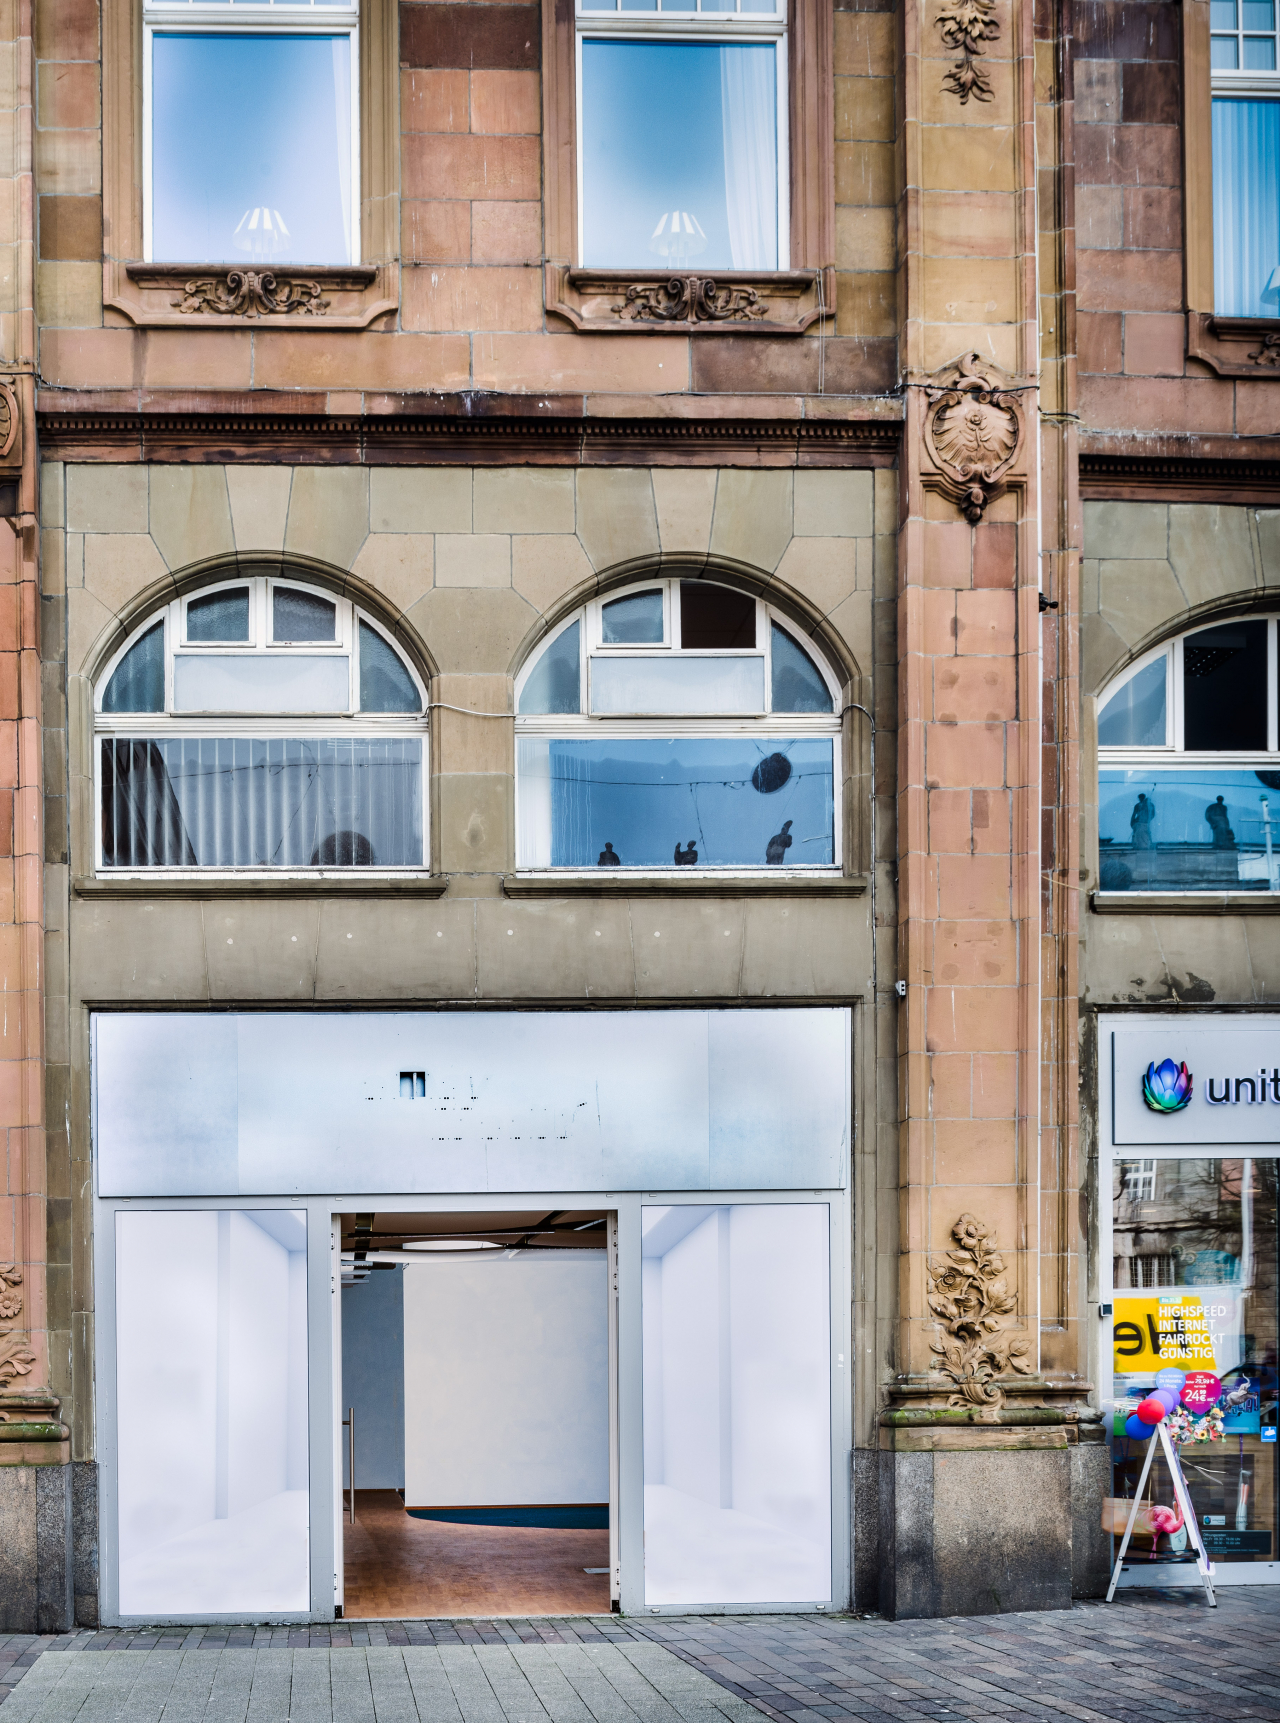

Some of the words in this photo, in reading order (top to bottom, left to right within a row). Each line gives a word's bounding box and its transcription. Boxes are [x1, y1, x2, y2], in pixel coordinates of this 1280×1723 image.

[1158, 1305, 1227, 1318] HIGHSPEED
[1158, 1319, 1216, 1331] INTERNET
[1158, 1333, 1226, 1345] FAIRRÜCKT
[1158, 1347, 1216, 1359] GÜNSTIG!
[1185, 1389, 1199, 1402] 24
